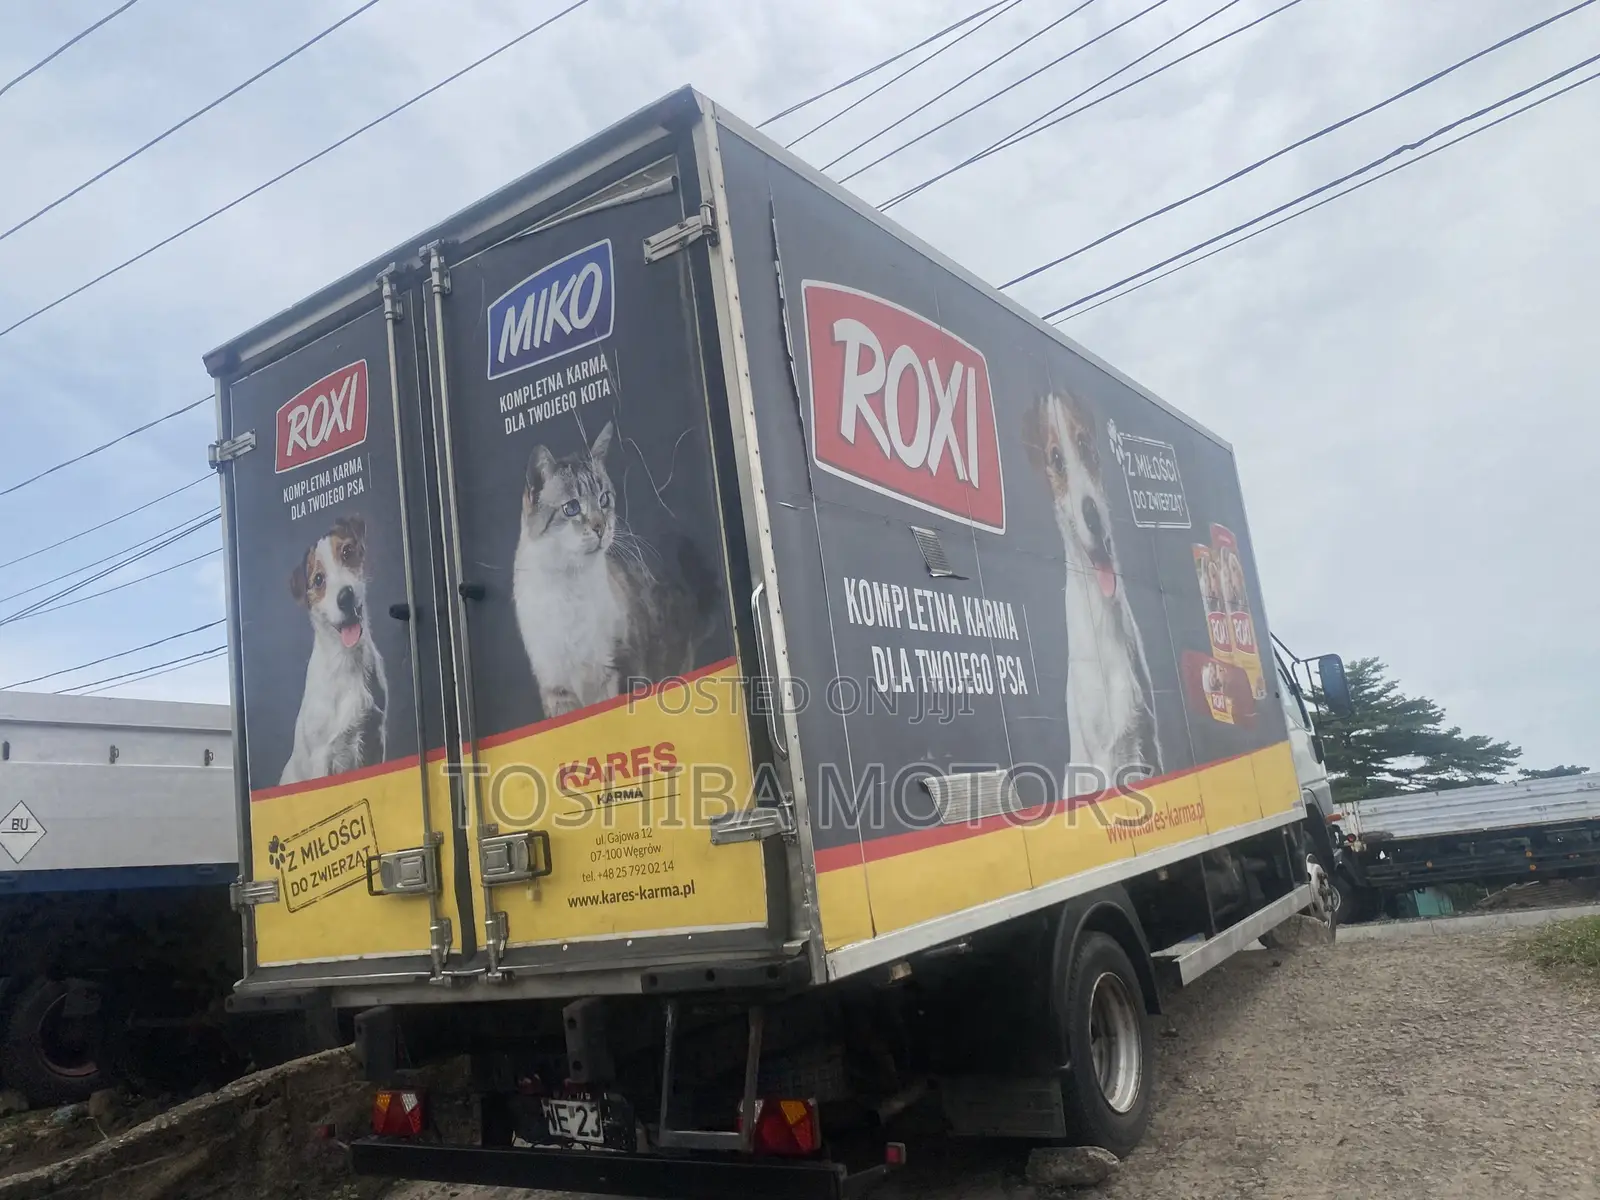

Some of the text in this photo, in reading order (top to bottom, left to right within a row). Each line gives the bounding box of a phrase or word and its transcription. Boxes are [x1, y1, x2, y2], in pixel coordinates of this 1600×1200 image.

[498, 262, 603, 363] MIKO
[500, 354, 609, 413] KOMPLETNA KARMA
[504, 378, 611, 435] DLA TWOJEGO KOTA
[833, 318, 979, 489] ROXI
[286, 371, 359, 457] ROXI
[283, 456, 363, 503] KOMPLETNA KARMA
[1125, 452, 1136, 477] Z
[291, 477, 365, 521] DLA TWOJEGO PSA
[1133, 490, 1146, 510] DO
[843, 577, 1019, 640] KOMPLETNA KARMA
[871, 645, 1028, 695] DLA TWOJEGO PSA
[558, 741, 678, 791] KARES
[597, 787, 644, 805] KARMA
[11, 818, 29, 831] BU
[286, 815, 367, 873] Z MIŁOŚCI
[608, 830, 640, 846] Gajowa
[642, 828, 653, 839] 12
[291, 845, 371, 898] DO ZWIERZĄT
[582, 860, 675, 883] tel. +48 25 792 02 14
[590, 844, 662, 863] 07-100 Węgrów
[567, 879, 696, 908] www.kares-karma.pl
